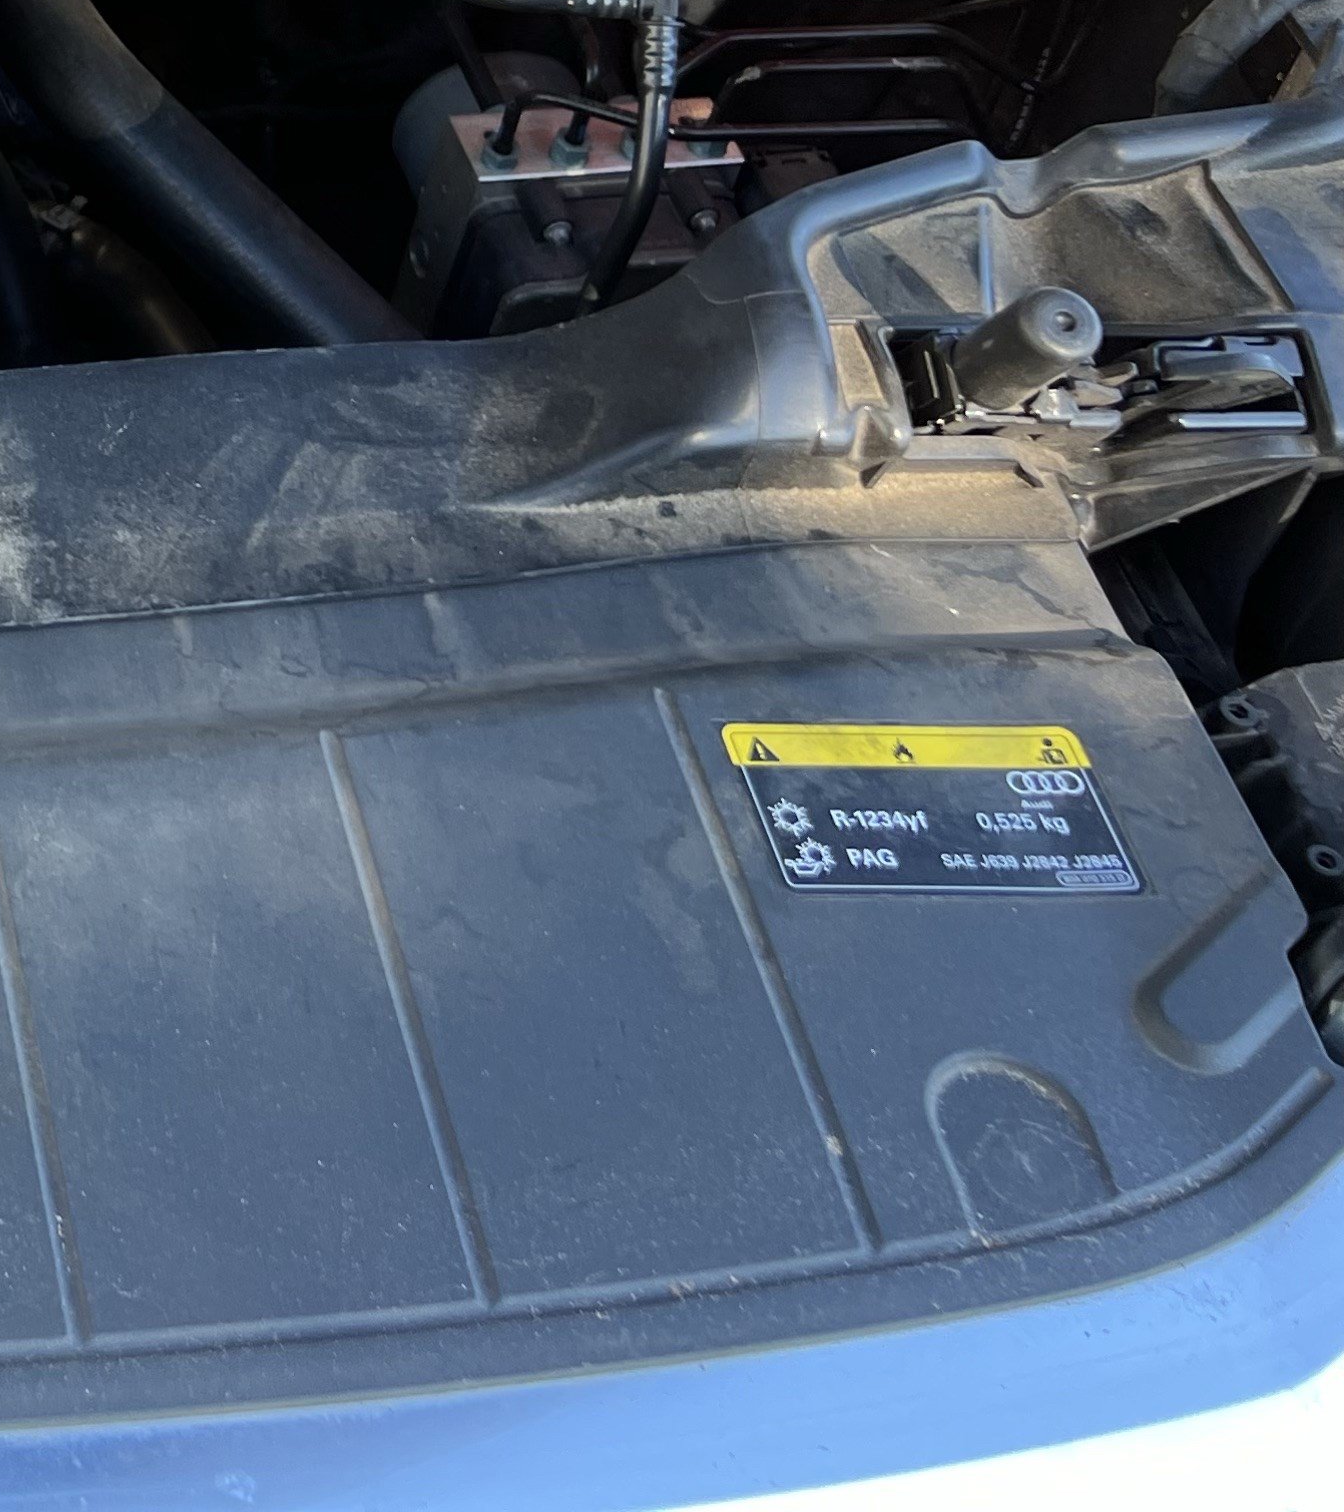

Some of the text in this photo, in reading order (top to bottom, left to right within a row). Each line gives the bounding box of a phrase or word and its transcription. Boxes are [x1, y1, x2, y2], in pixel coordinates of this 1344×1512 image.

[829, 808, 1070, 835] R-1234yf 0,525 kg
[845, 847, 899, 870] PAG
[940, 852, 975, 870] SAE
